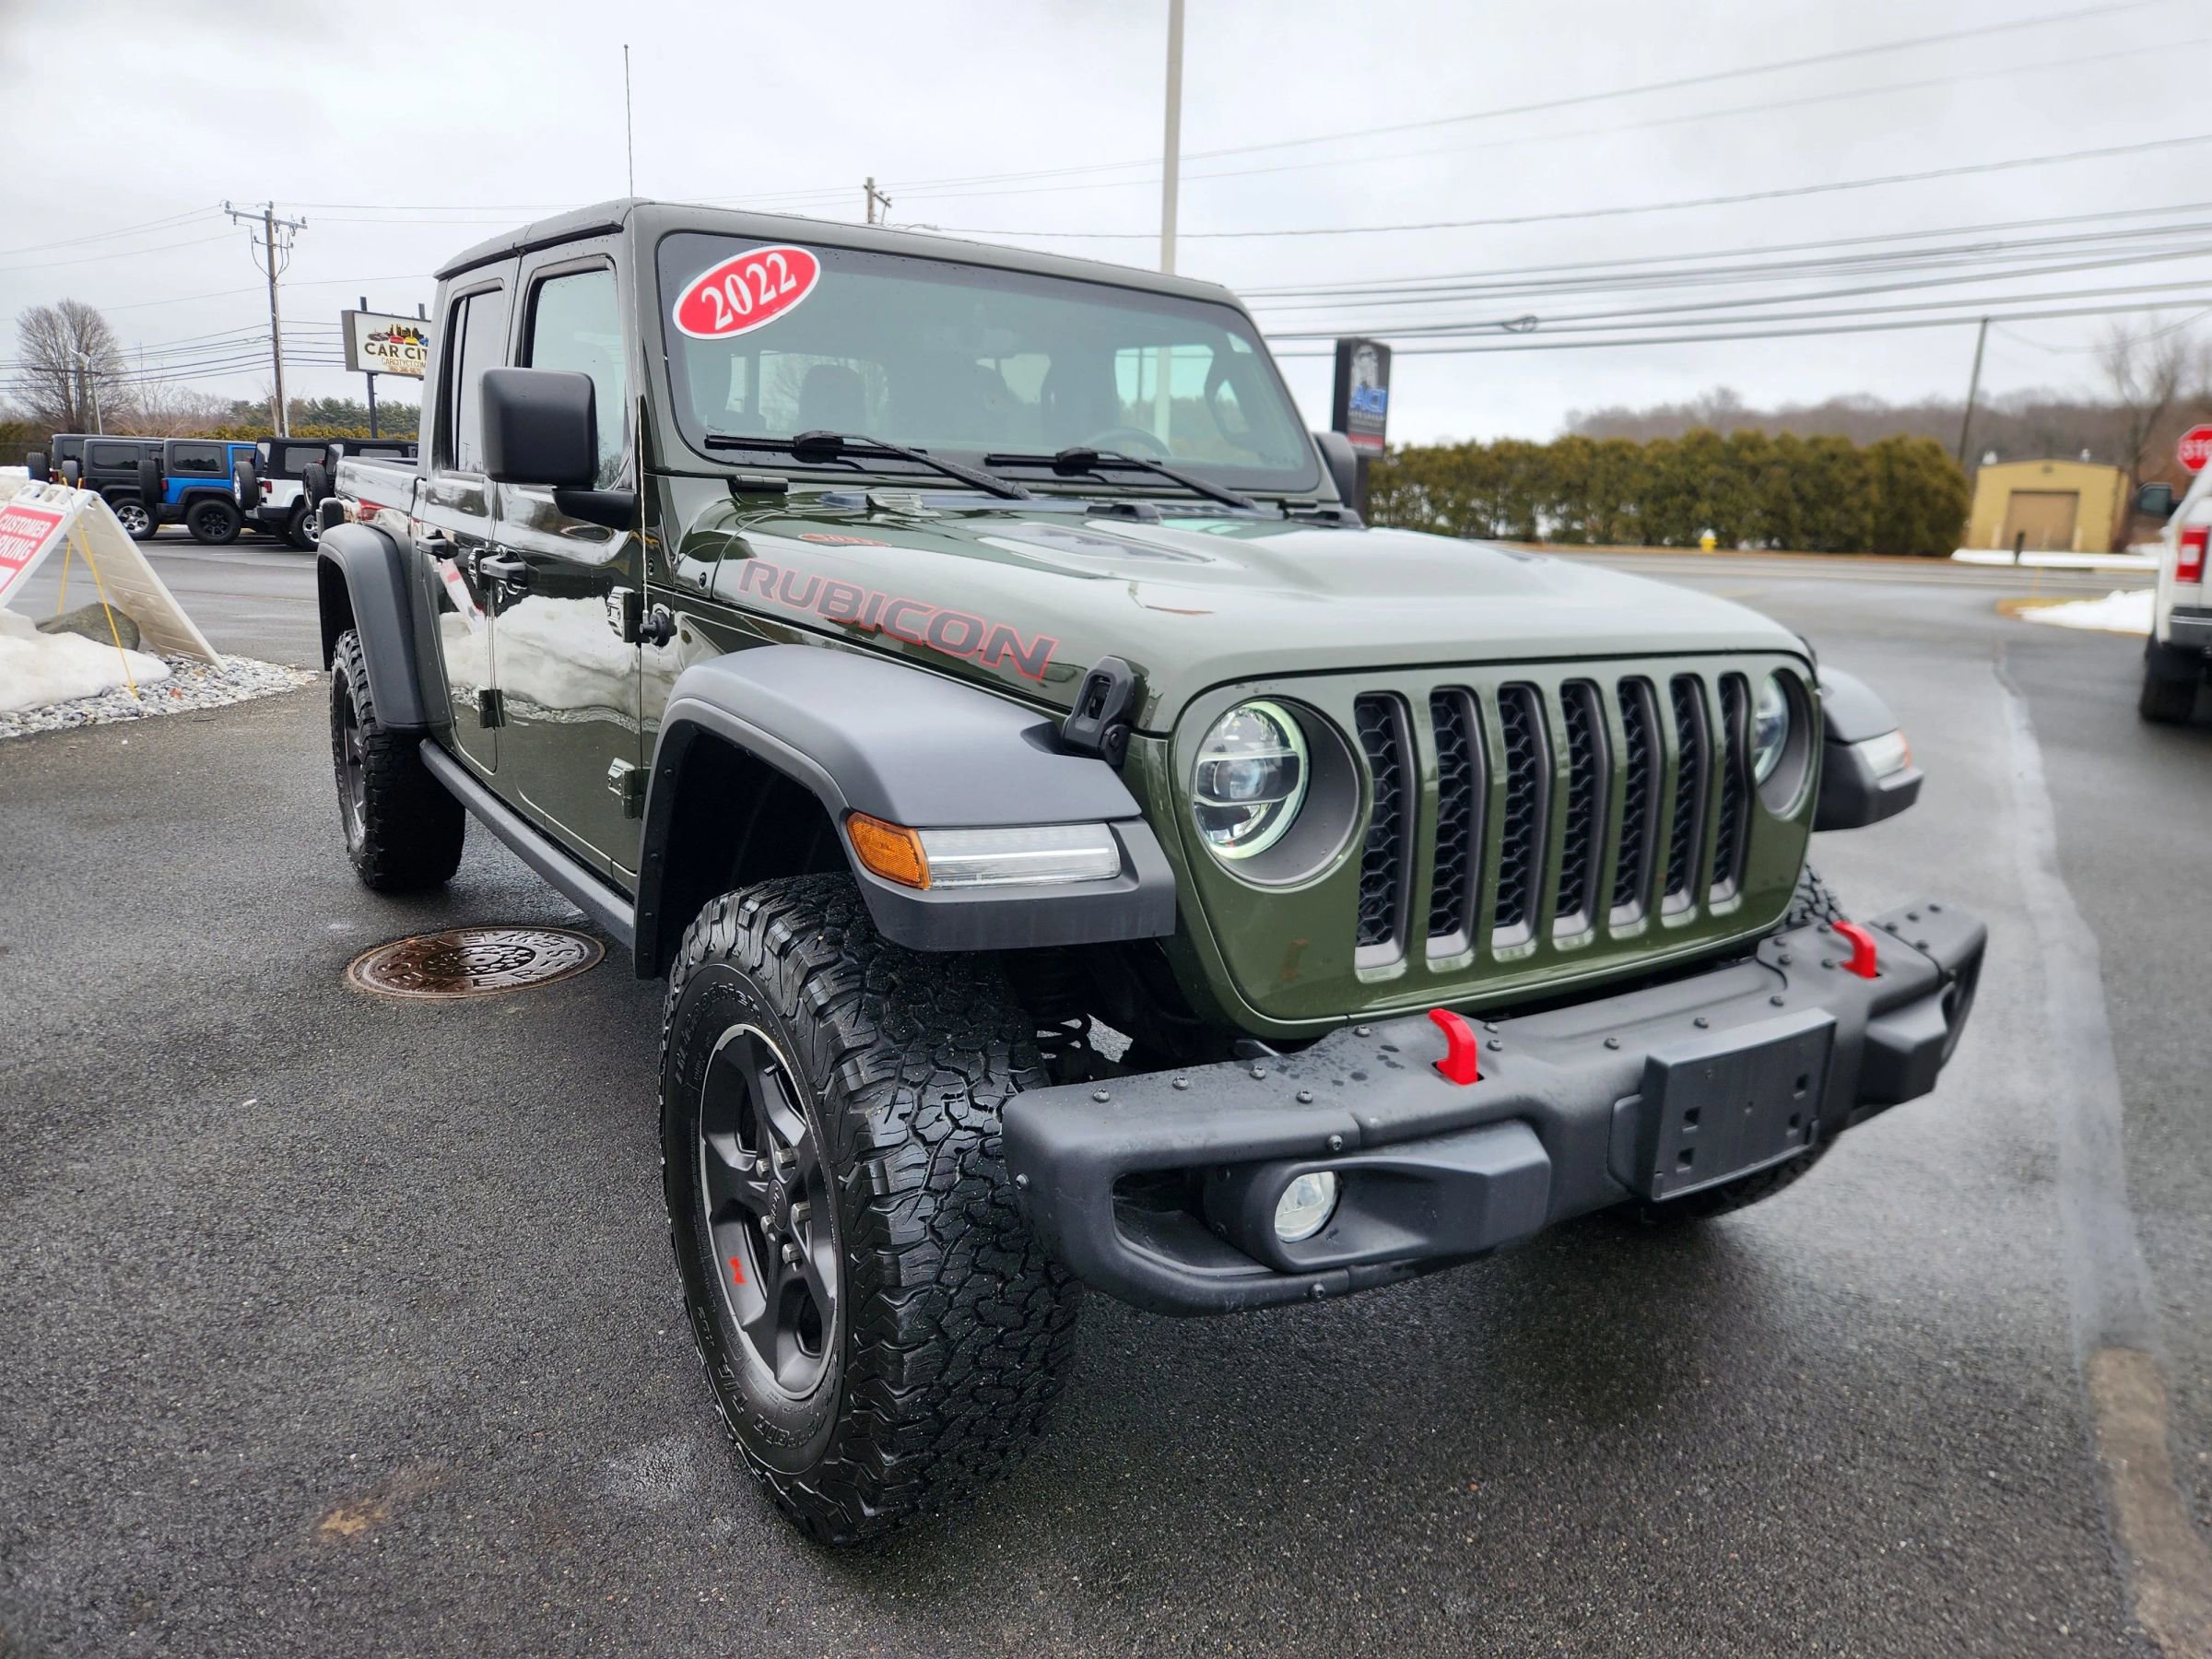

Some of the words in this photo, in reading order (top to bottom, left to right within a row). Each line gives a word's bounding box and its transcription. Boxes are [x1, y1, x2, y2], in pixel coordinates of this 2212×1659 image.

[700, 252, 797, 330] 2022
[364, 342, 399, 358] CAR
[739, 559, 1058, 679] RUBICON
